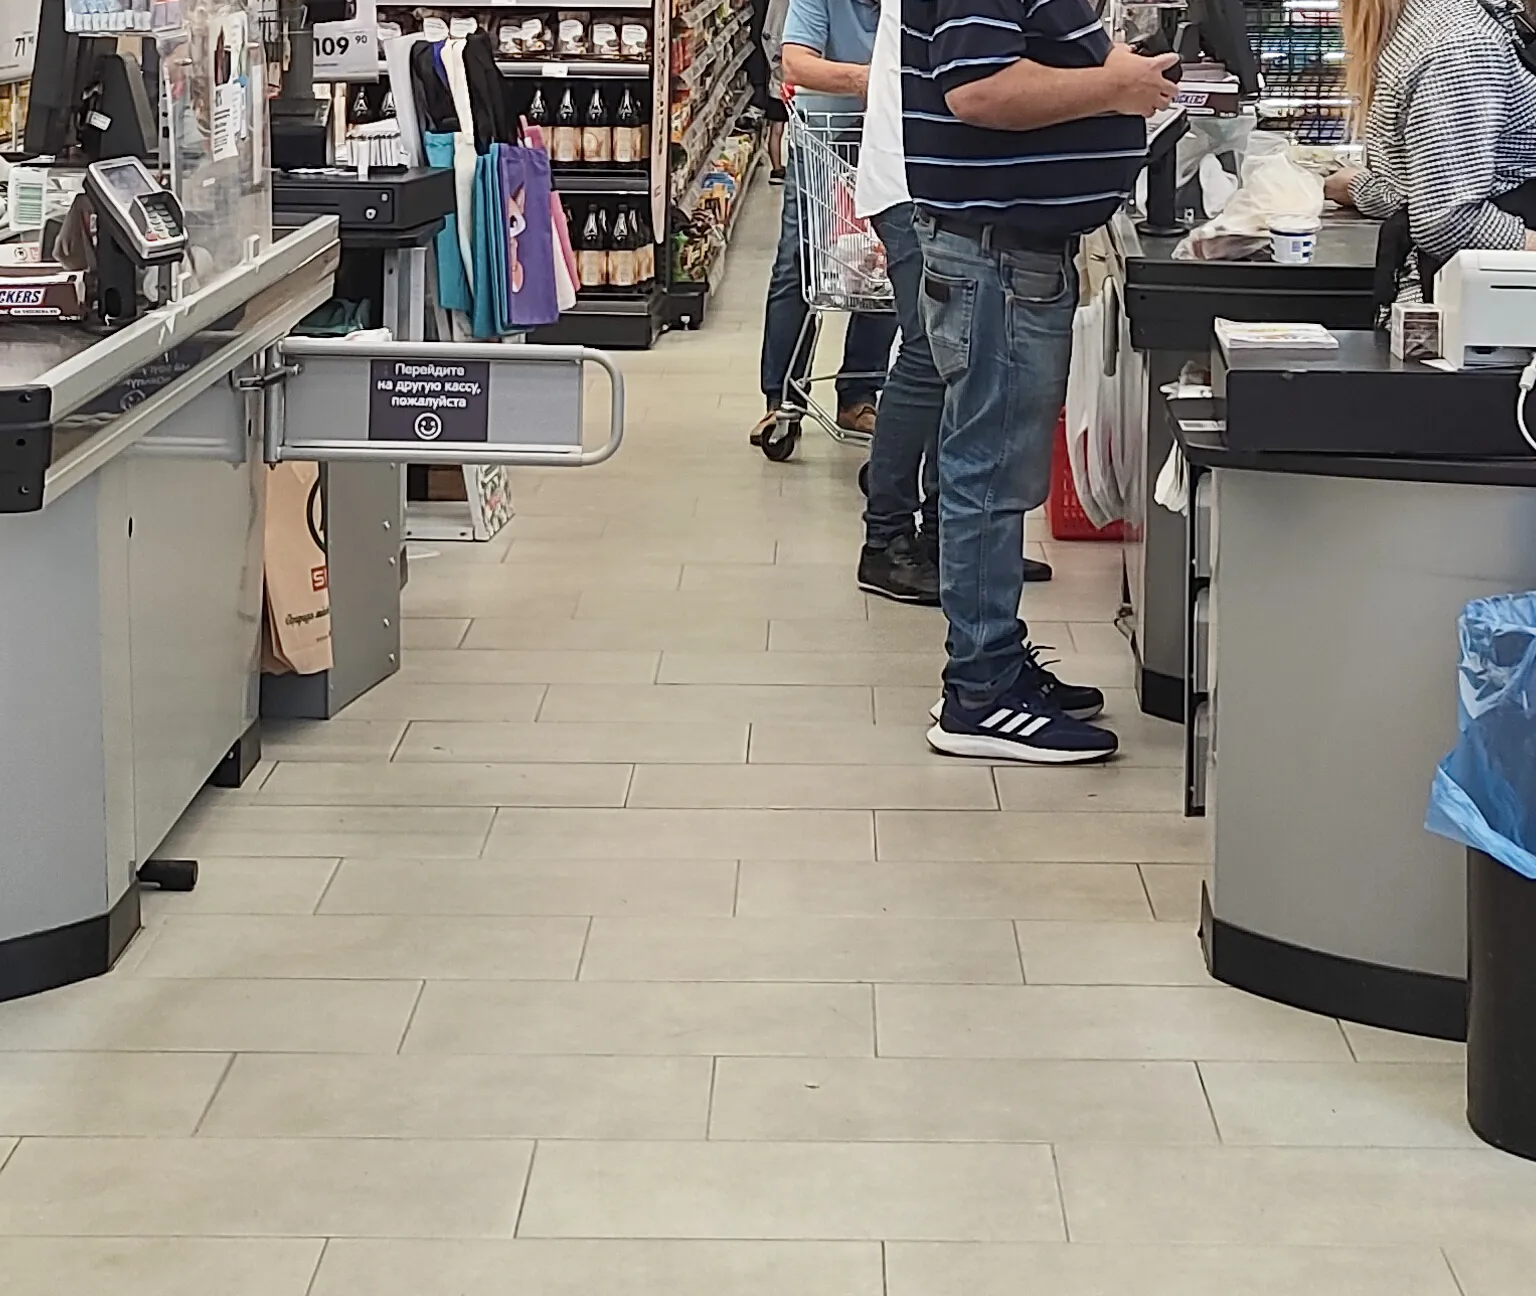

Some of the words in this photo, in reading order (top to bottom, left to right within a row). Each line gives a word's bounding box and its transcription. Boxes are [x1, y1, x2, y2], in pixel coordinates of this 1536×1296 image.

[313, 36, 349, 56] 109
[355, 35, 368, 44] 90
[395, 362, 465, 378] Перейдите
[377, 380, 393, 390] на
[395, 380, 442, 394] другую
[444, 381, 482, 395] кассу,
[391, 395, 467, 410] пожалуйста
